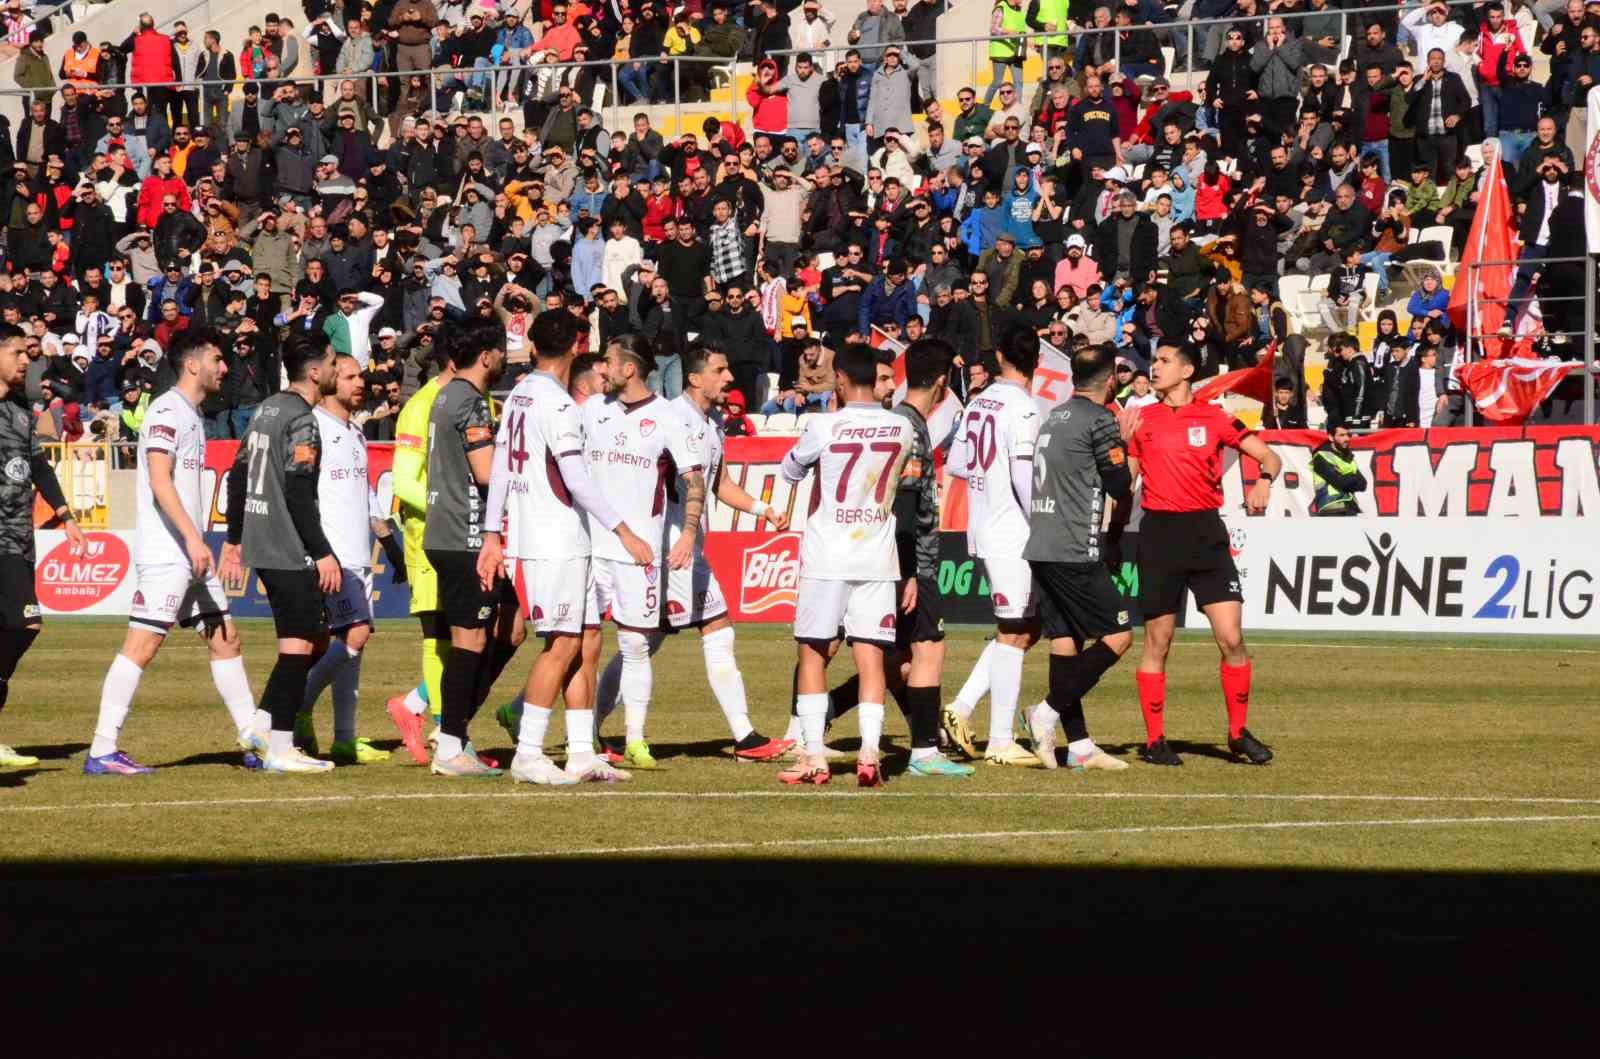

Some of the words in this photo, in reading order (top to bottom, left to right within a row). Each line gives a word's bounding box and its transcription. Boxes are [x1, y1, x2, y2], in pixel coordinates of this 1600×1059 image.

[508, 411, 530, 473] 14
[838, 426, 902, 440] PROEM
[967, 412, 997, 472] 50
[830, 443, 902, 503] 77
[43, 559, 120, 582] ÖLMEZ
[55, 586, 102, 598] ambalaj
[646, 586, 657, 609] 5
